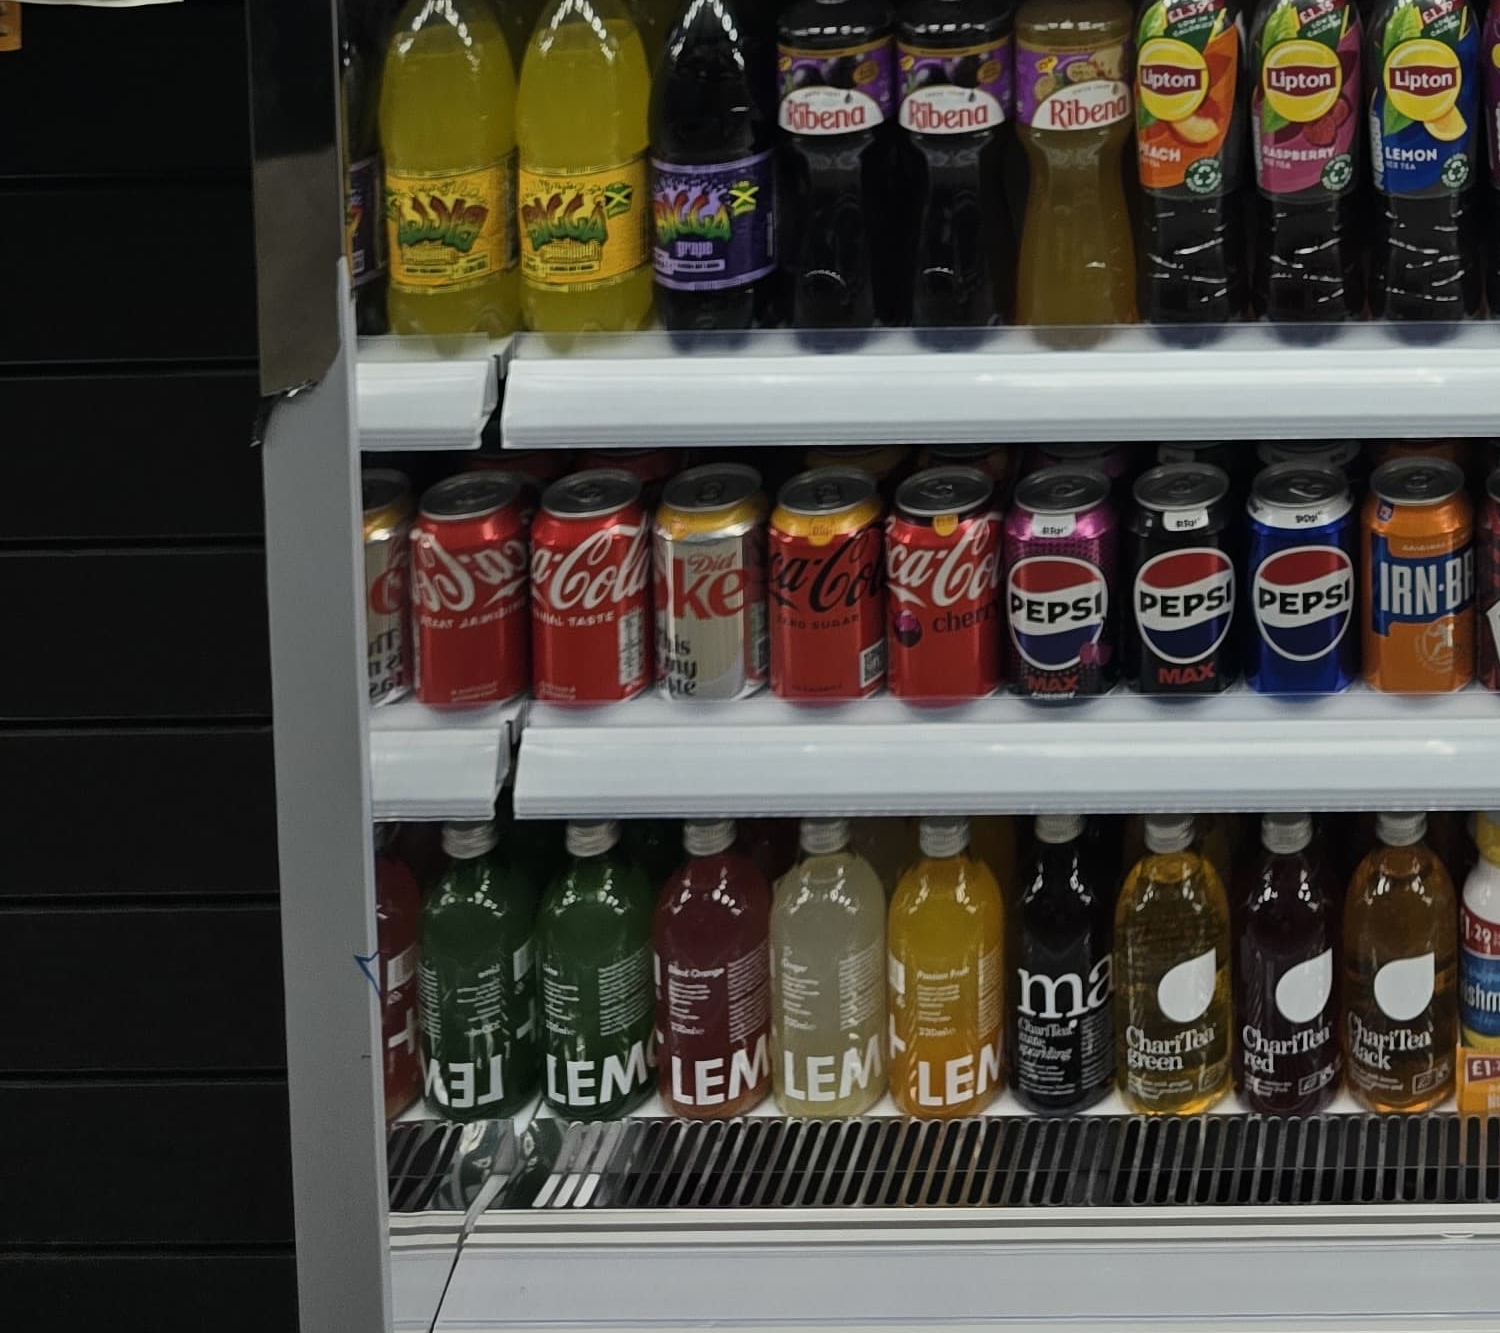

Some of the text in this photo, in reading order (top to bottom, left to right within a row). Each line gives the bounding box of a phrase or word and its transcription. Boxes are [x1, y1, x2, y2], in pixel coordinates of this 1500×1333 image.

[1141, 71, 1196, 90] Lipton
[1270, 70, 1331, 90] Lipton
[1394, 70, 1453, 90] Lipton
[785, 100, 866, 129] Ribena
[907, 99, 989, 129] Ribena
[1049, 94, 1128, 129] Ribena
[1386, 147, 1438, 162] LEMON
[568, 611, 616, 627] TASTE
[1028, 674, 1079, 691] MAX
[1158, 662, 1215, 685] MAX
[1126, 1023, 1217, 1056] ChariTea
[1243, 1025, 1333, 1056] ChariTea
[670, 1034, 771, 1106] LEM
[1127, 1051, 1184, 1071] green
[546, 1040, 649, 1106] LEM
